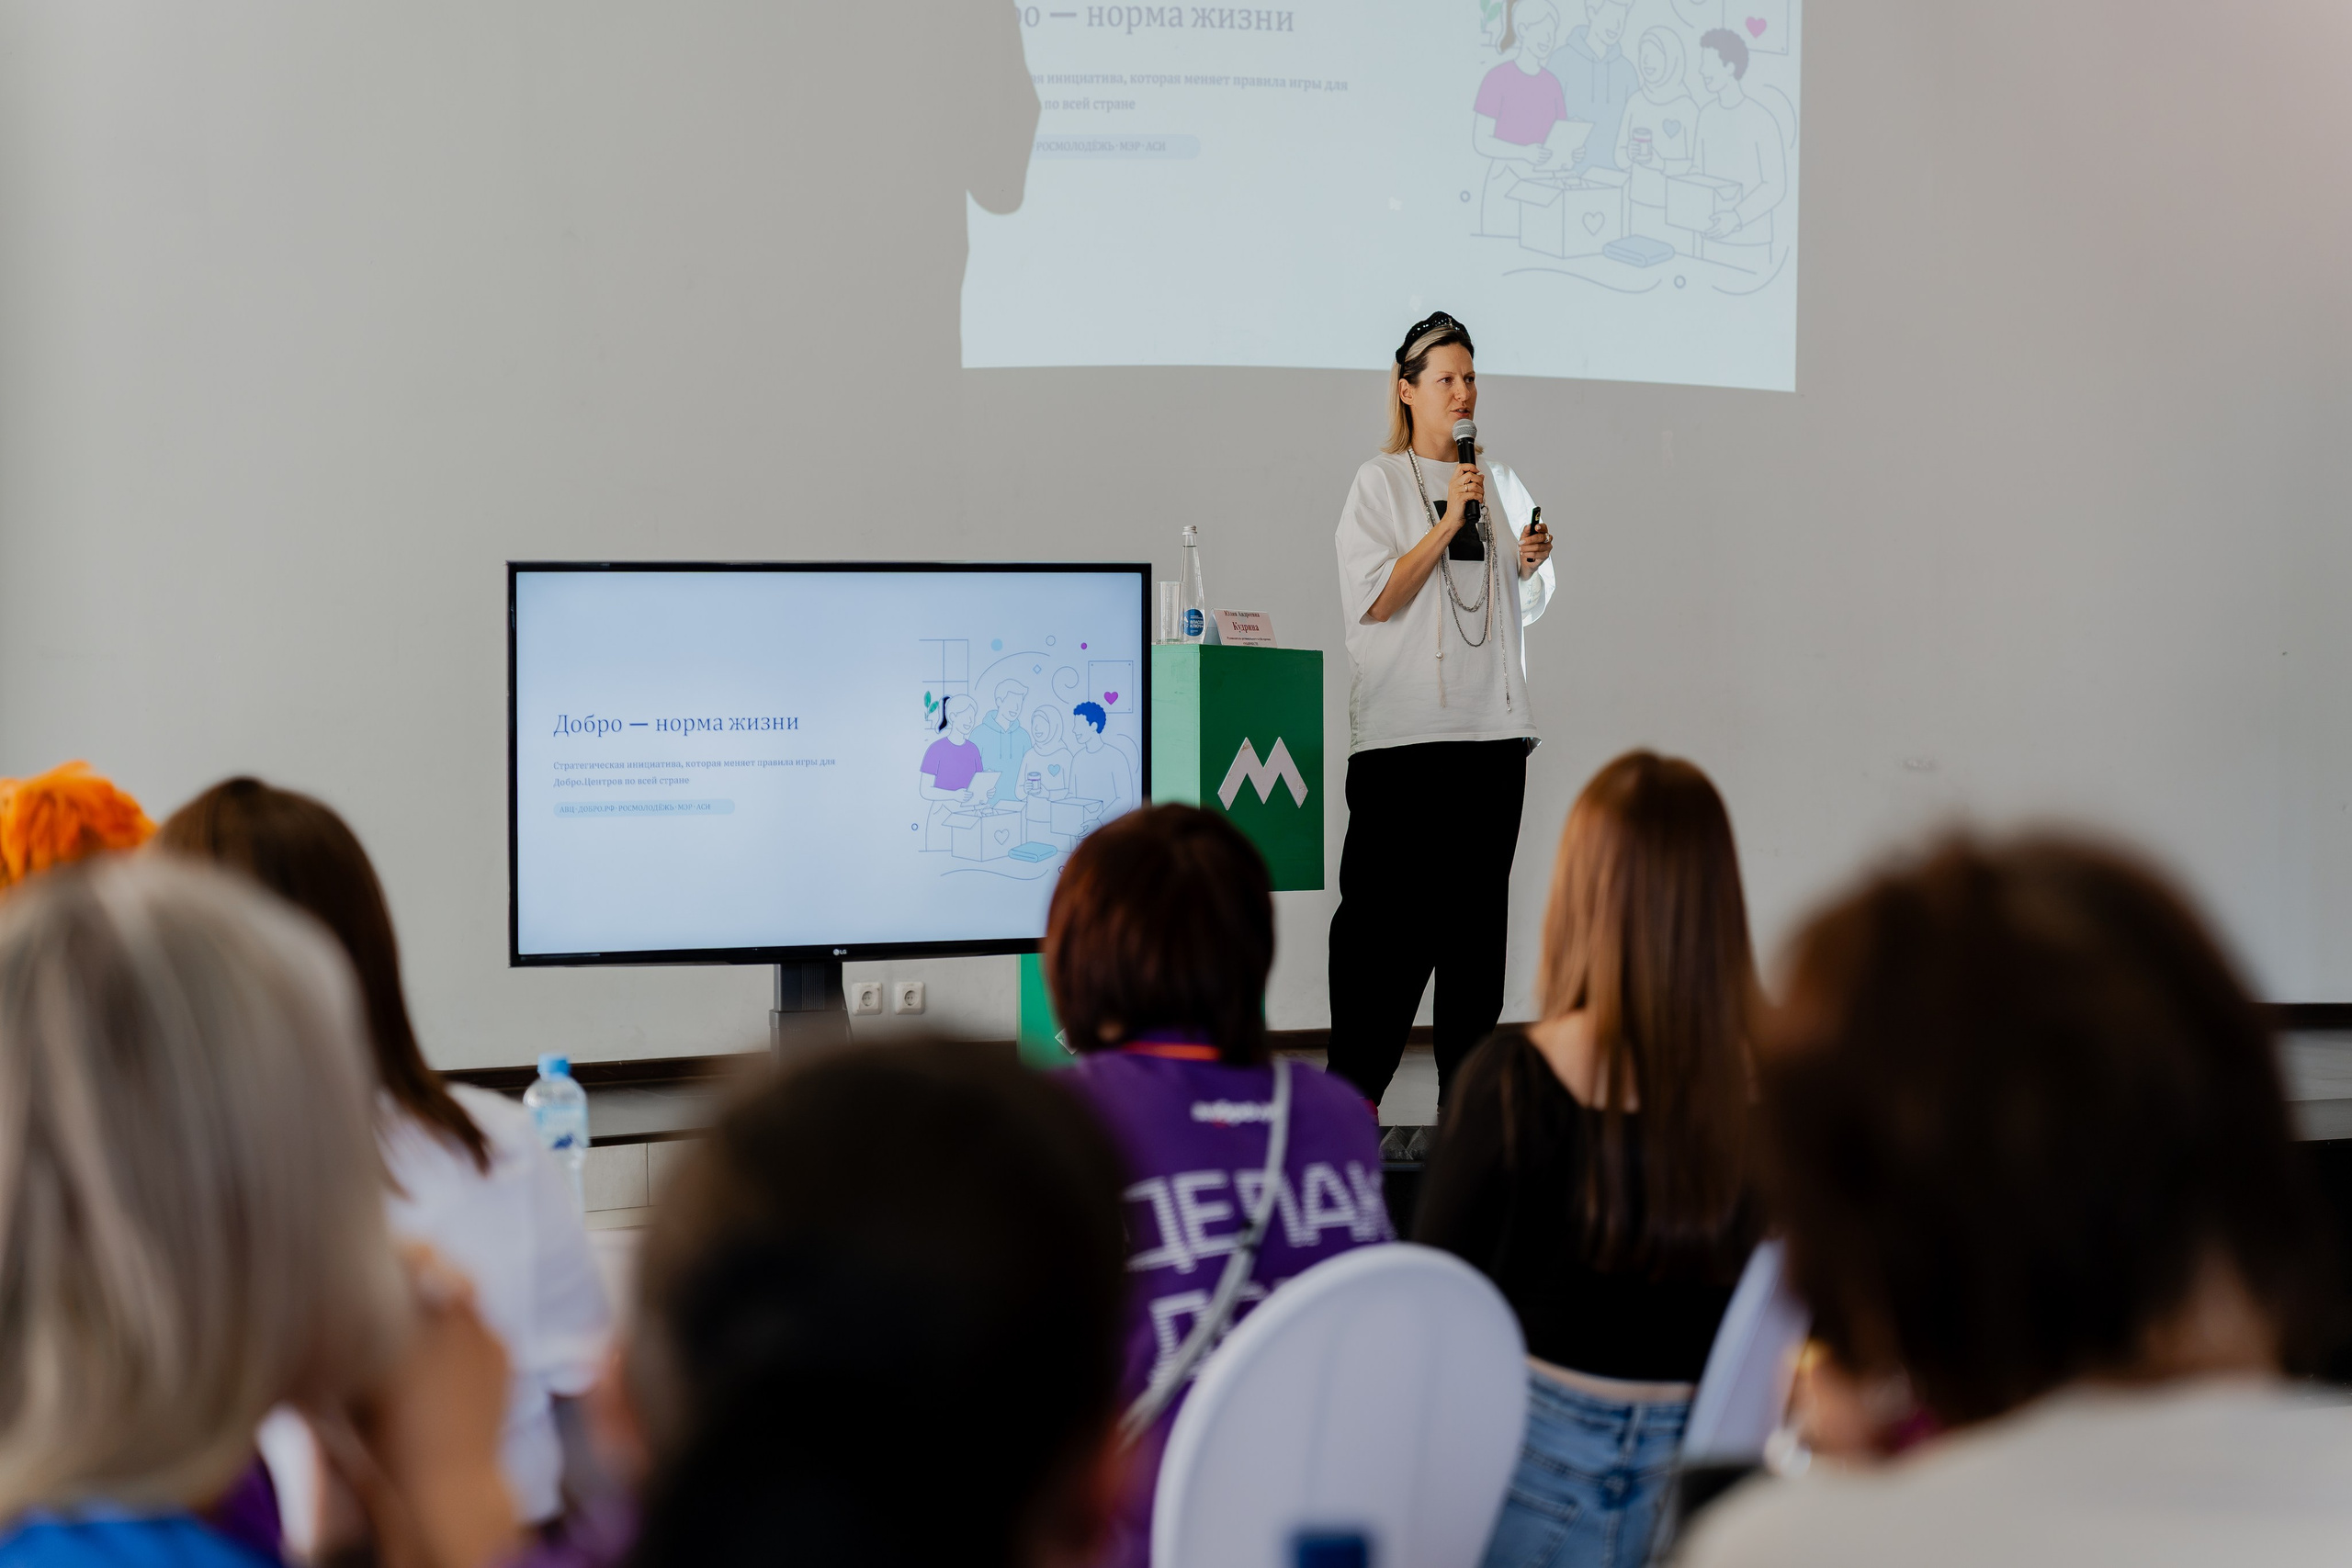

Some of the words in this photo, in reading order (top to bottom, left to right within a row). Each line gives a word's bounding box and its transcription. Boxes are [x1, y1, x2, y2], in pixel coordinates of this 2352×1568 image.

[1087, 5, 1184, 35] норма
[1191, 6, 1295, 32] жизни
[1046, 73, 1128, 86] инициатива,
[1129, 73, 1182, 87] которая
[1183, 74, 1231, 86] меняет
[1233, 75, 1287, 89] правила
[1288, 77, 1322, 92] игры
[1323, 79, 1349, 93] для
[1044, 99, 1060, 111] по
[1062, 96, 1091, 111] всей
[1092, 99, 1136, 114] стране
[1231, 621, 1260, 633] Кудрина
[553, 713, 623, 738] Добро
[655, 716, 723, 737] норма
[728, 715, 799, 731] жизни
[553, 761, 625, 772] Стратегическая
[627, 760, 684, 770] инициатива,
[685, 760, 721, 770] которая
[723, 759, 756, 768] меняет
[757, 759, 794, 769] правила
[795, 758, 819, 768] игры
[819, 757, 835, 767] для
[553, 777, 623, 788] Добро.Центров
[624, 778, 636, 786] по
[637, 776, 658, 785] всей
[659, 777, 690, 787] стране
